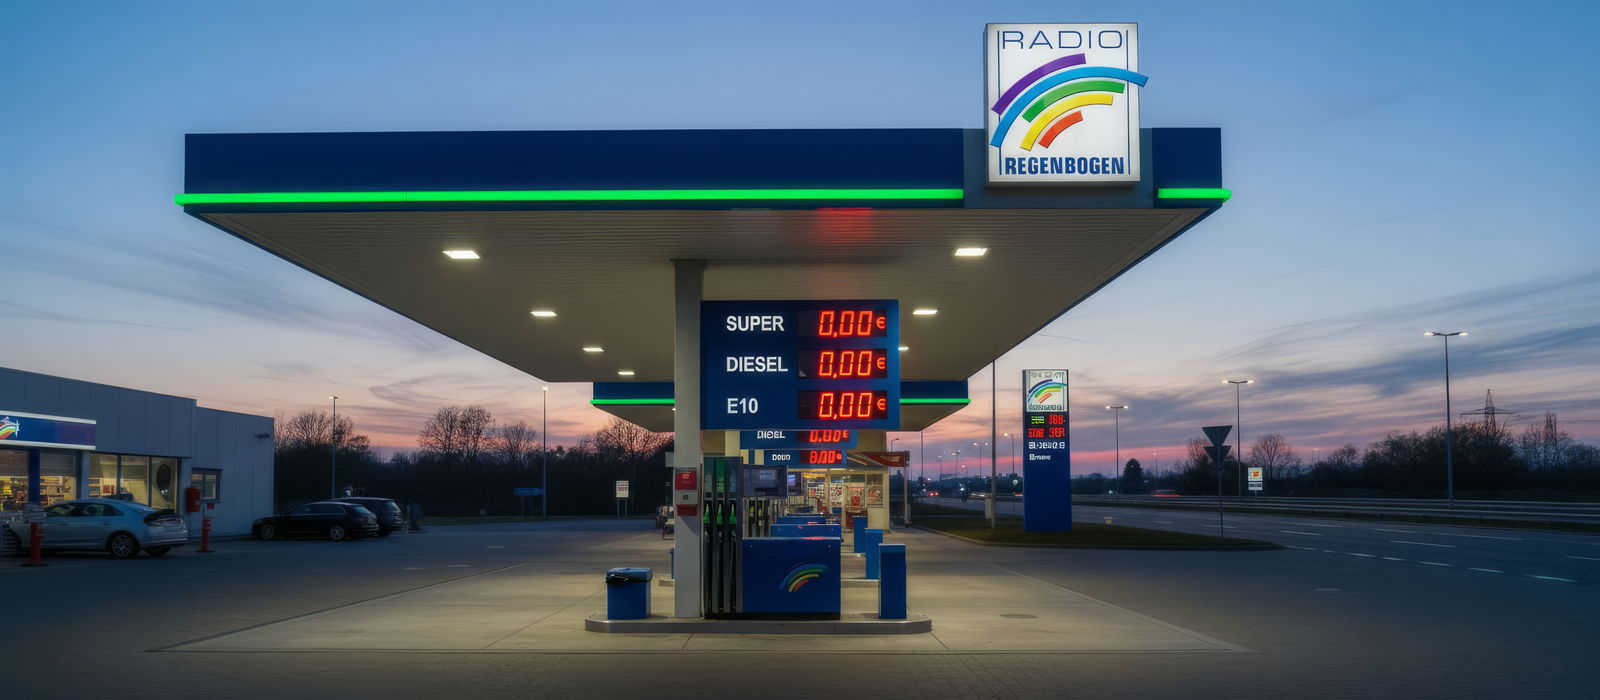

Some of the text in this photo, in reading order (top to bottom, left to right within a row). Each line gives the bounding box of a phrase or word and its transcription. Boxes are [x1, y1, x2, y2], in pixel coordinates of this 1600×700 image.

[1002, 30, 1123, 49] RADIO
[1005, 157, 1124, 175] REGENBOGEN
[726, 315, 785, 332] SUPER
[726, 356, 789, 373] DIESEL
[727, 397, 759, 414] E10
